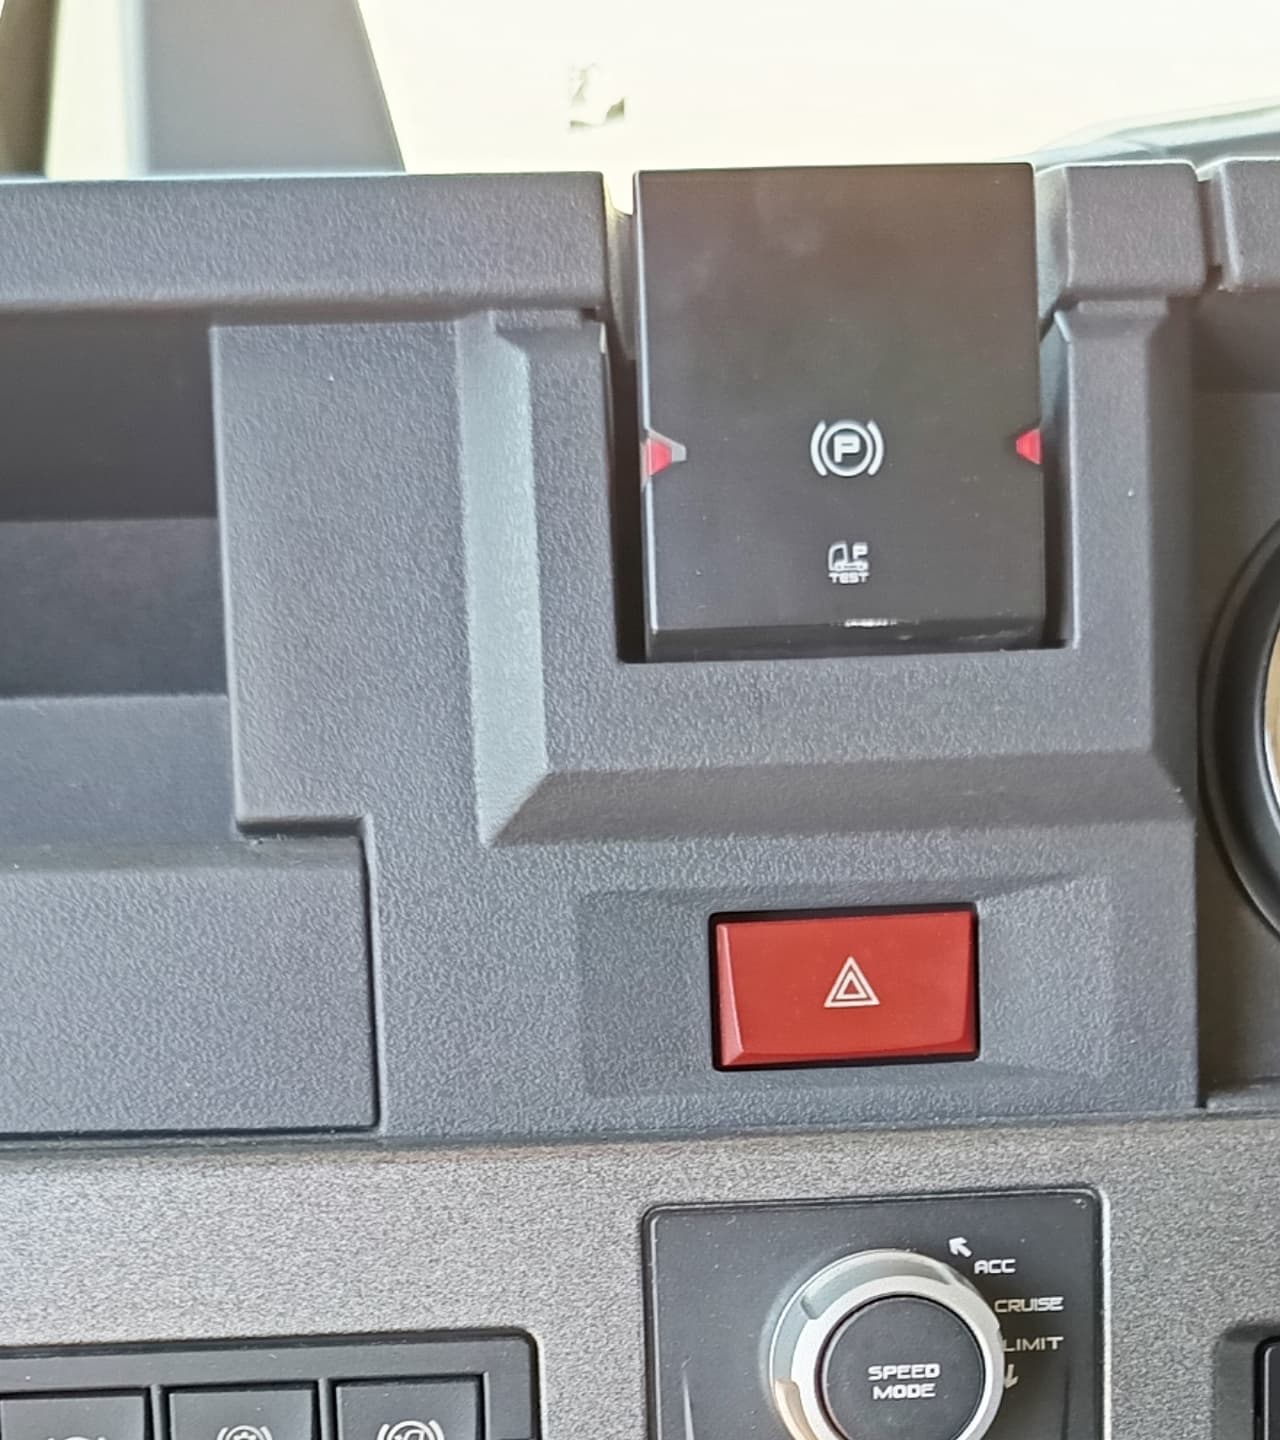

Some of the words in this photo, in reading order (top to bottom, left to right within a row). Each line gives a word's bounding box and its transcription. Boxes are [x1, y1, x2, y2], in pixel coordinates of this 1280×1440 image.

[833, 433, 860, 463] P
[828, 572, 869, 584] TEST
[974, 1258, 1016, 1274] ACC
[994, 1296, 1064, 1313] CRUISE
[1002, 1336, 1064, 1352] LIMIT
[867, 1363, 940, 1381] SPEED
[873, 1383, 936, 1400] MODE
